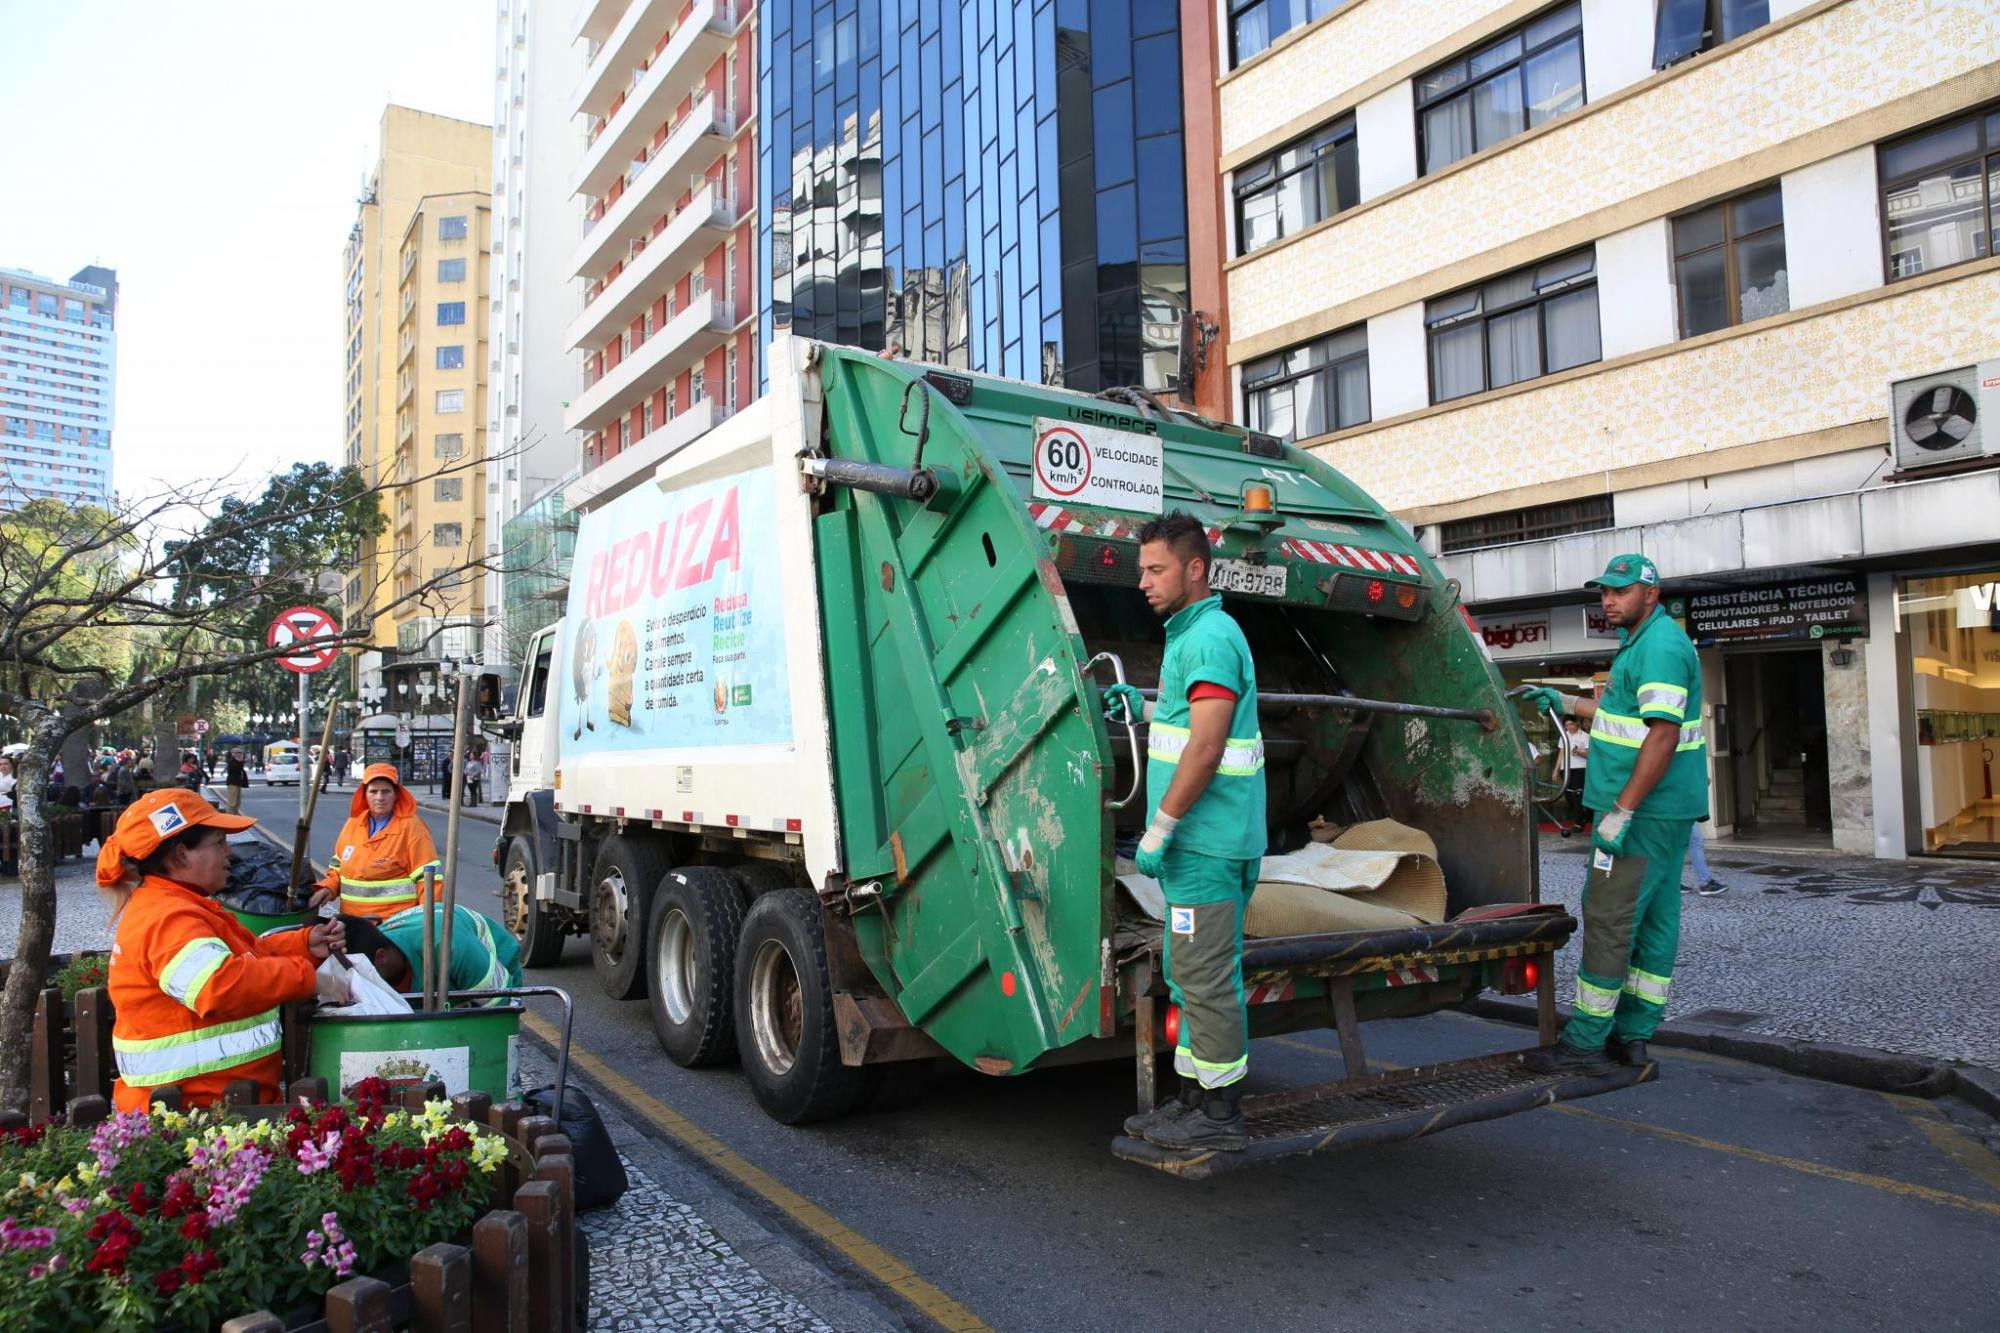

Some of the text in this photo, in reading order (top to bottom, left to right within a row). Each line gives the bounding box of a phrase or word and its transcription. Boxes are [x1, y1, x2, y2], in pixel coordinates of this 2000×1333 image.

[1048, 439, 1080, 470] 60
[1095, 447, 1159, 467] VELOCIDADE
[1050, 470, 1077, 484] km/h
[1091, 476, 1160, 496] CONTROLADA
[585, 485, 741, 619] REDUZA
[714, 594, 748, 613] Reduza
[1691, 581, 1856, 607] ASSISTÊNCIA TÉCNICA
[1691, 603, 1779, 619] COMPUTADORES
[1789, 596, 1856, 611] NOTEBOOK
[1697, 618, 1760, 631] CELULARES
[1804, 610, 1850, 622] TABLET
[645, 638, 653, 651] de
[1482, 623, 1547, 649] bigben
[667, 651, 692, 669] sempre
[645, 669, 703, 691] a quantidade certa
[645, 697, 653, 710] de
